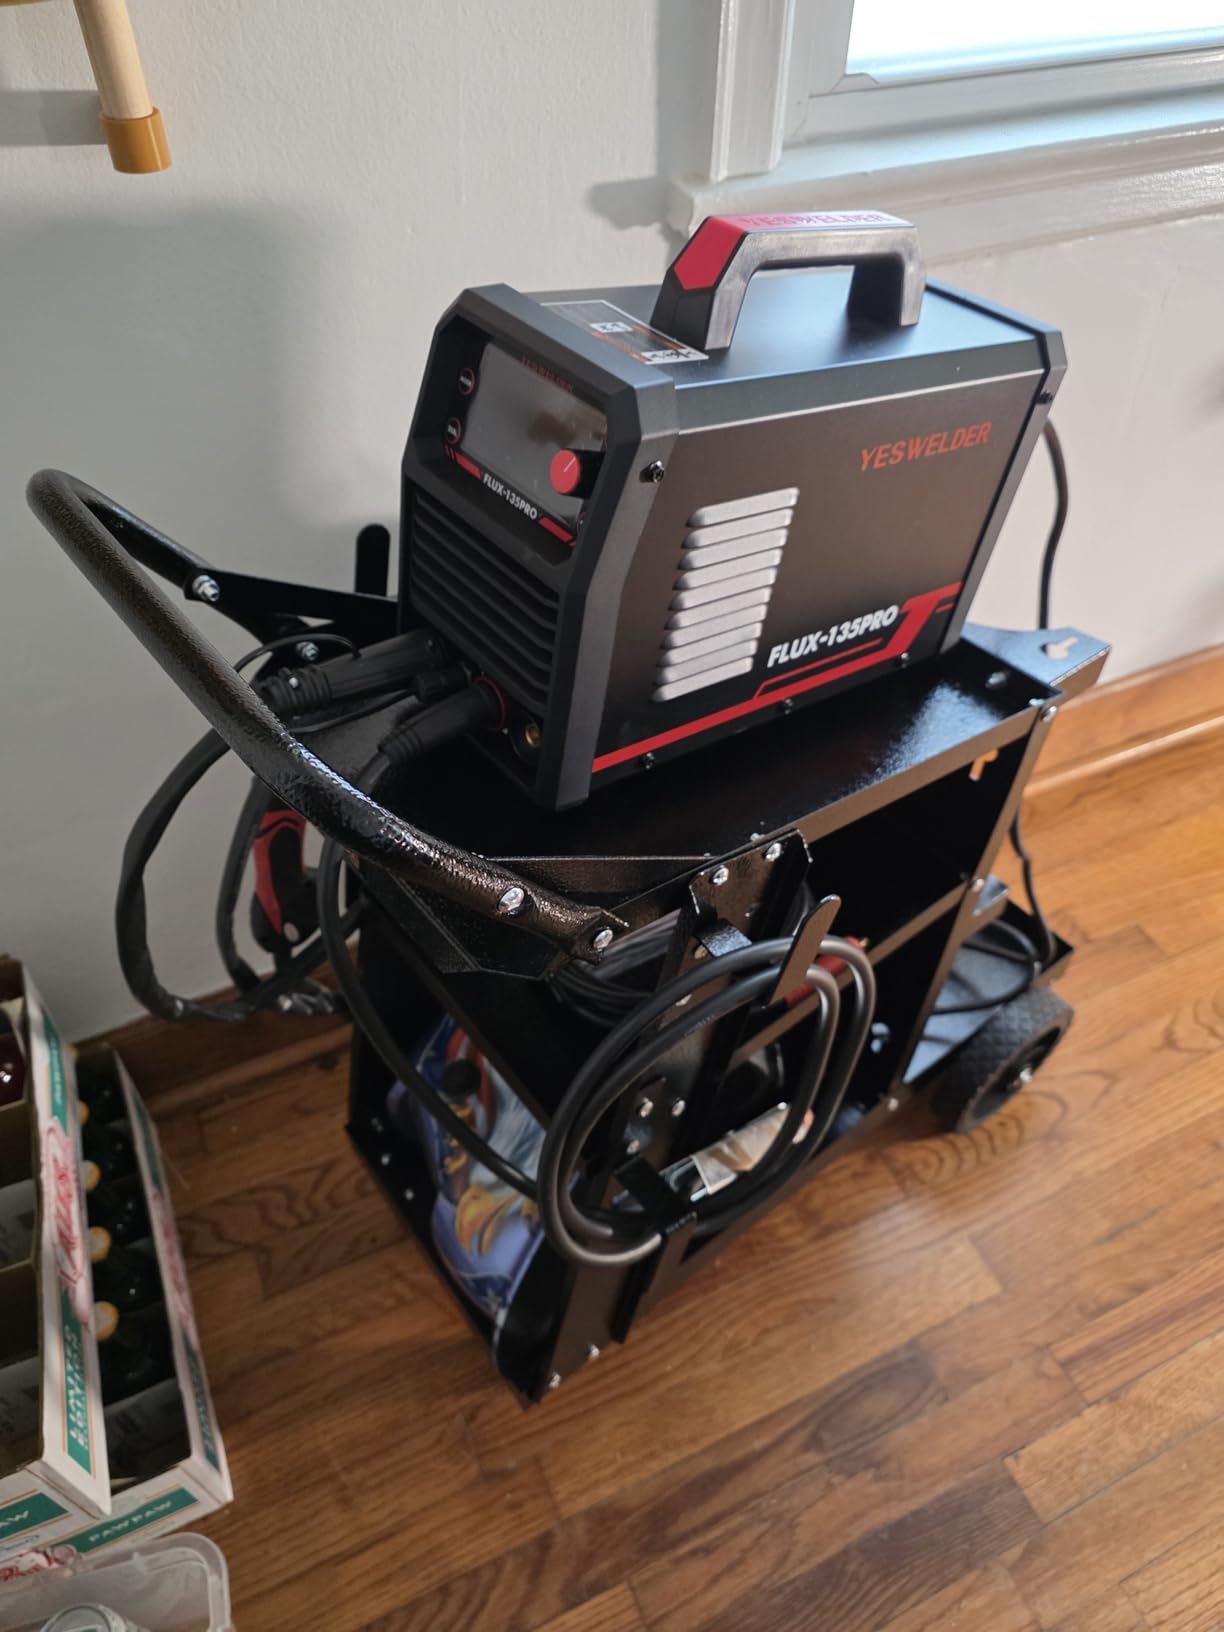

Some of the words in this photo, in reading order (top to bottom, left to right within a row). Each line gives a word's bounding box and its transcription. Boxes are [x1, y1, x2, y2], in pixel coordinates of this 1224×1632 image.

[861, 421, 993, 472] YESWELDER
[482, 473, 538, 520] FLUX-135PRO
[767, 604, 900, 668] FLUX-135PRO
